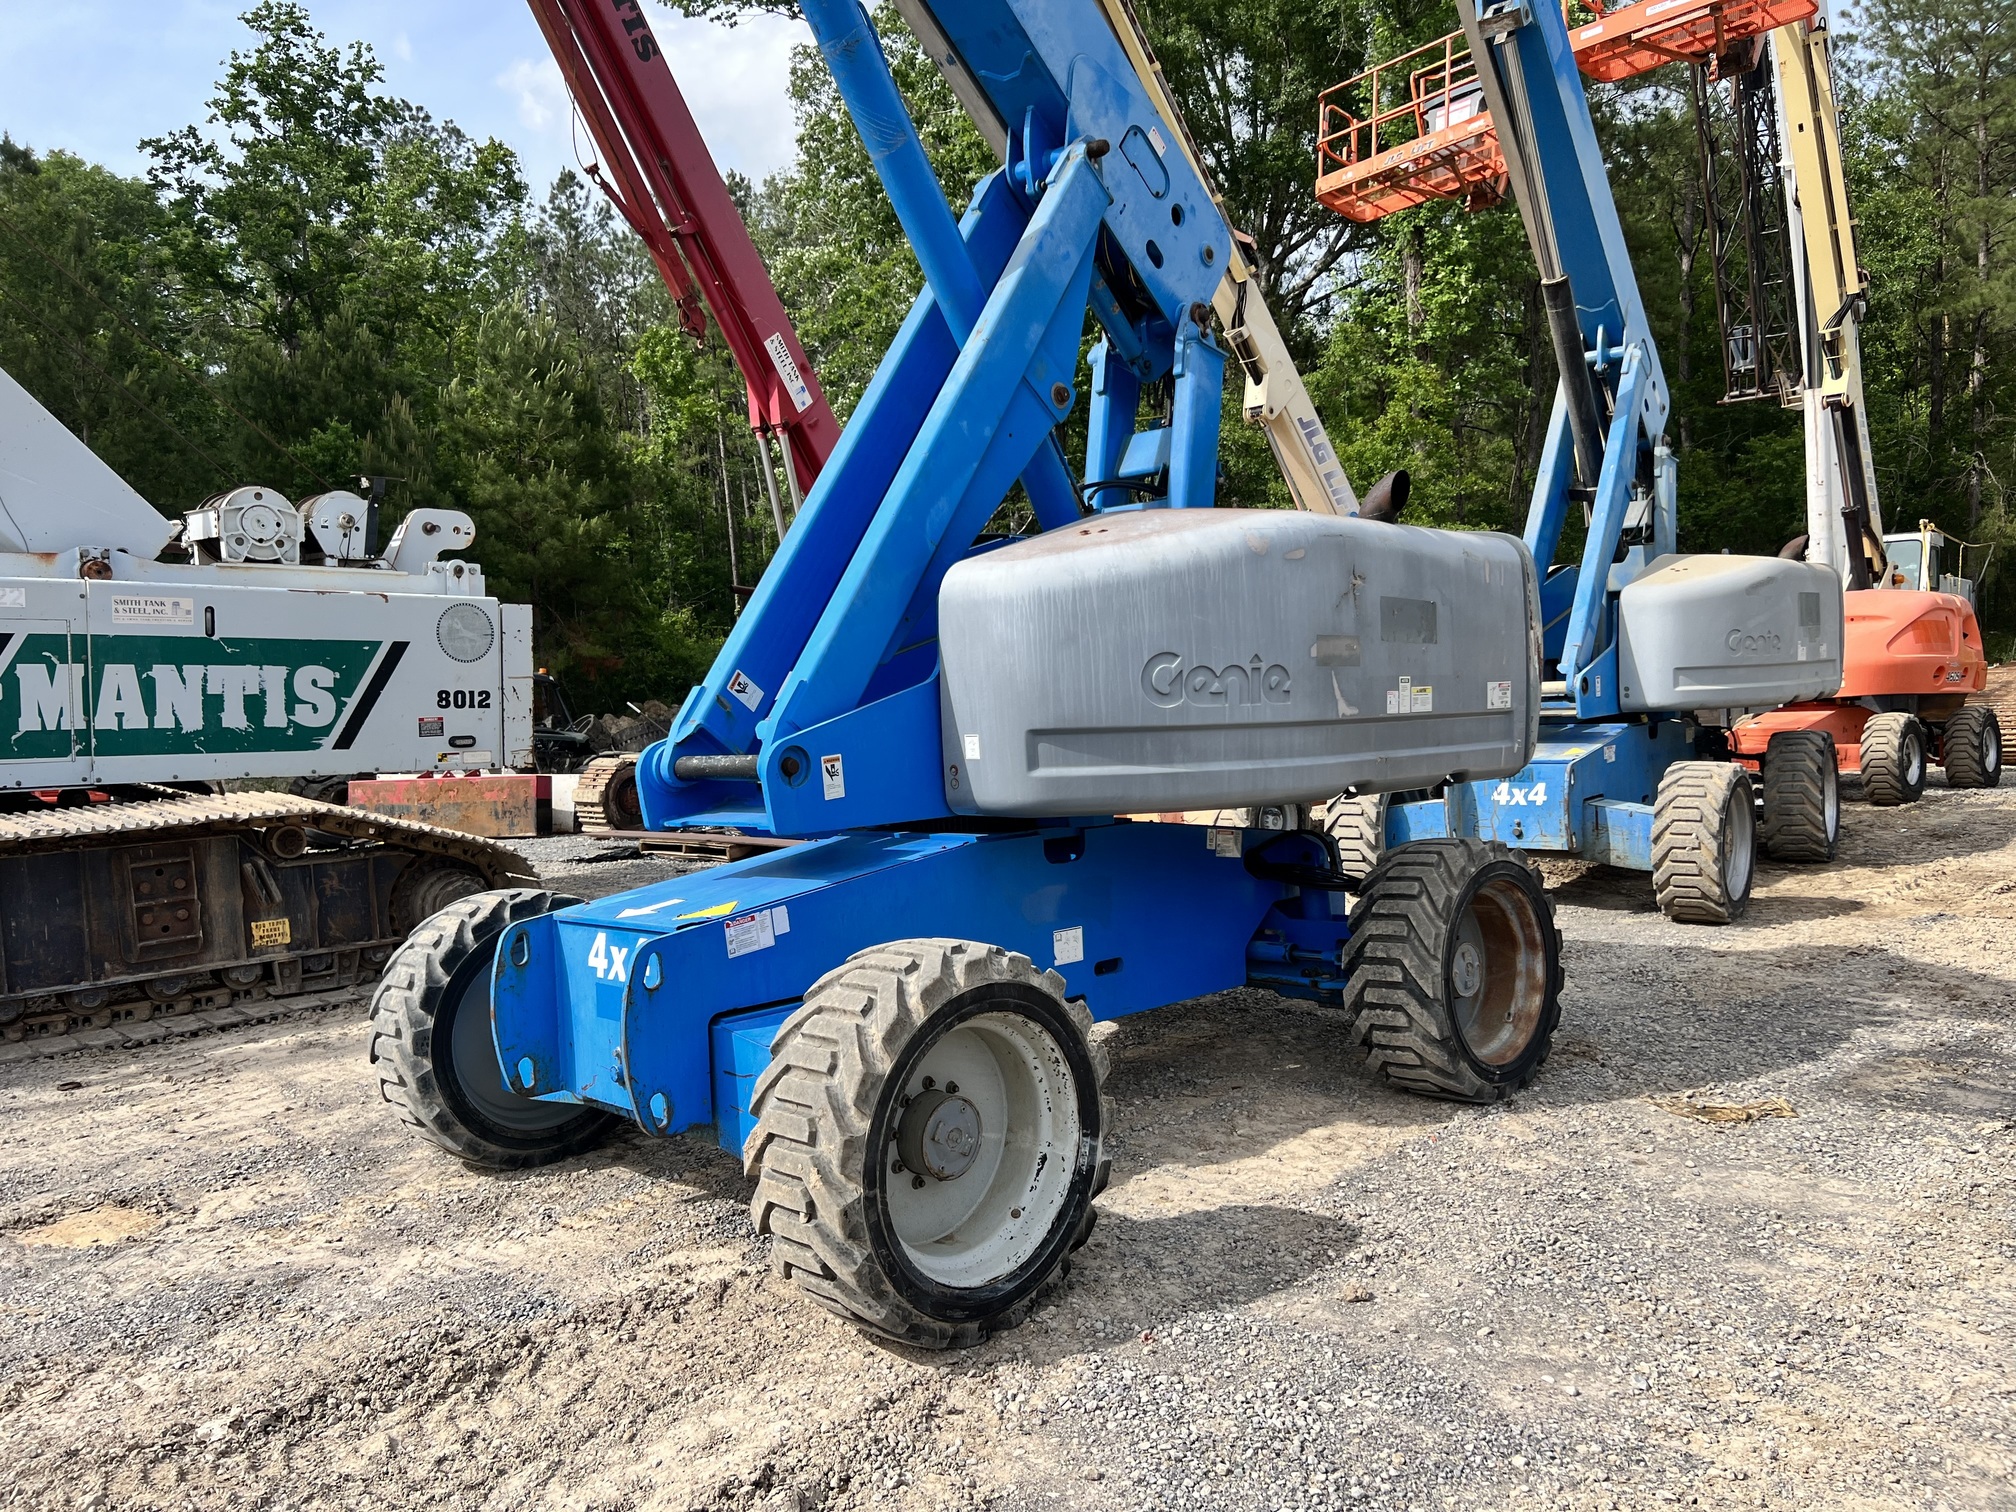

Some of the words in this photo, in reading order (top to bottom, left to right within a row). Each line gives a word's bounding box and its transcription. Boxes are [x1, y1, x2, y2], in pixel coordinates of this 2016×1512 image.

[775, 334, 790, 360] SMITH
[788, 361, 800, 382] TANK
[1296, 416, 1334, 467] JLG
[113, 599, 141, 607] SMITH
[143, 600, 167, 608] TANK
[152, 608, 169, 616] INC.
[1725, 628, 1781, 658] Genie
[14, 663, 338, 733] MANTIS
[436, 689, 491, 709] 8012
[1141, 651, 1292, 708] Genie
[1491, 782, 1548, 806] 4x4
[587, 931, 648, 982] 4x
